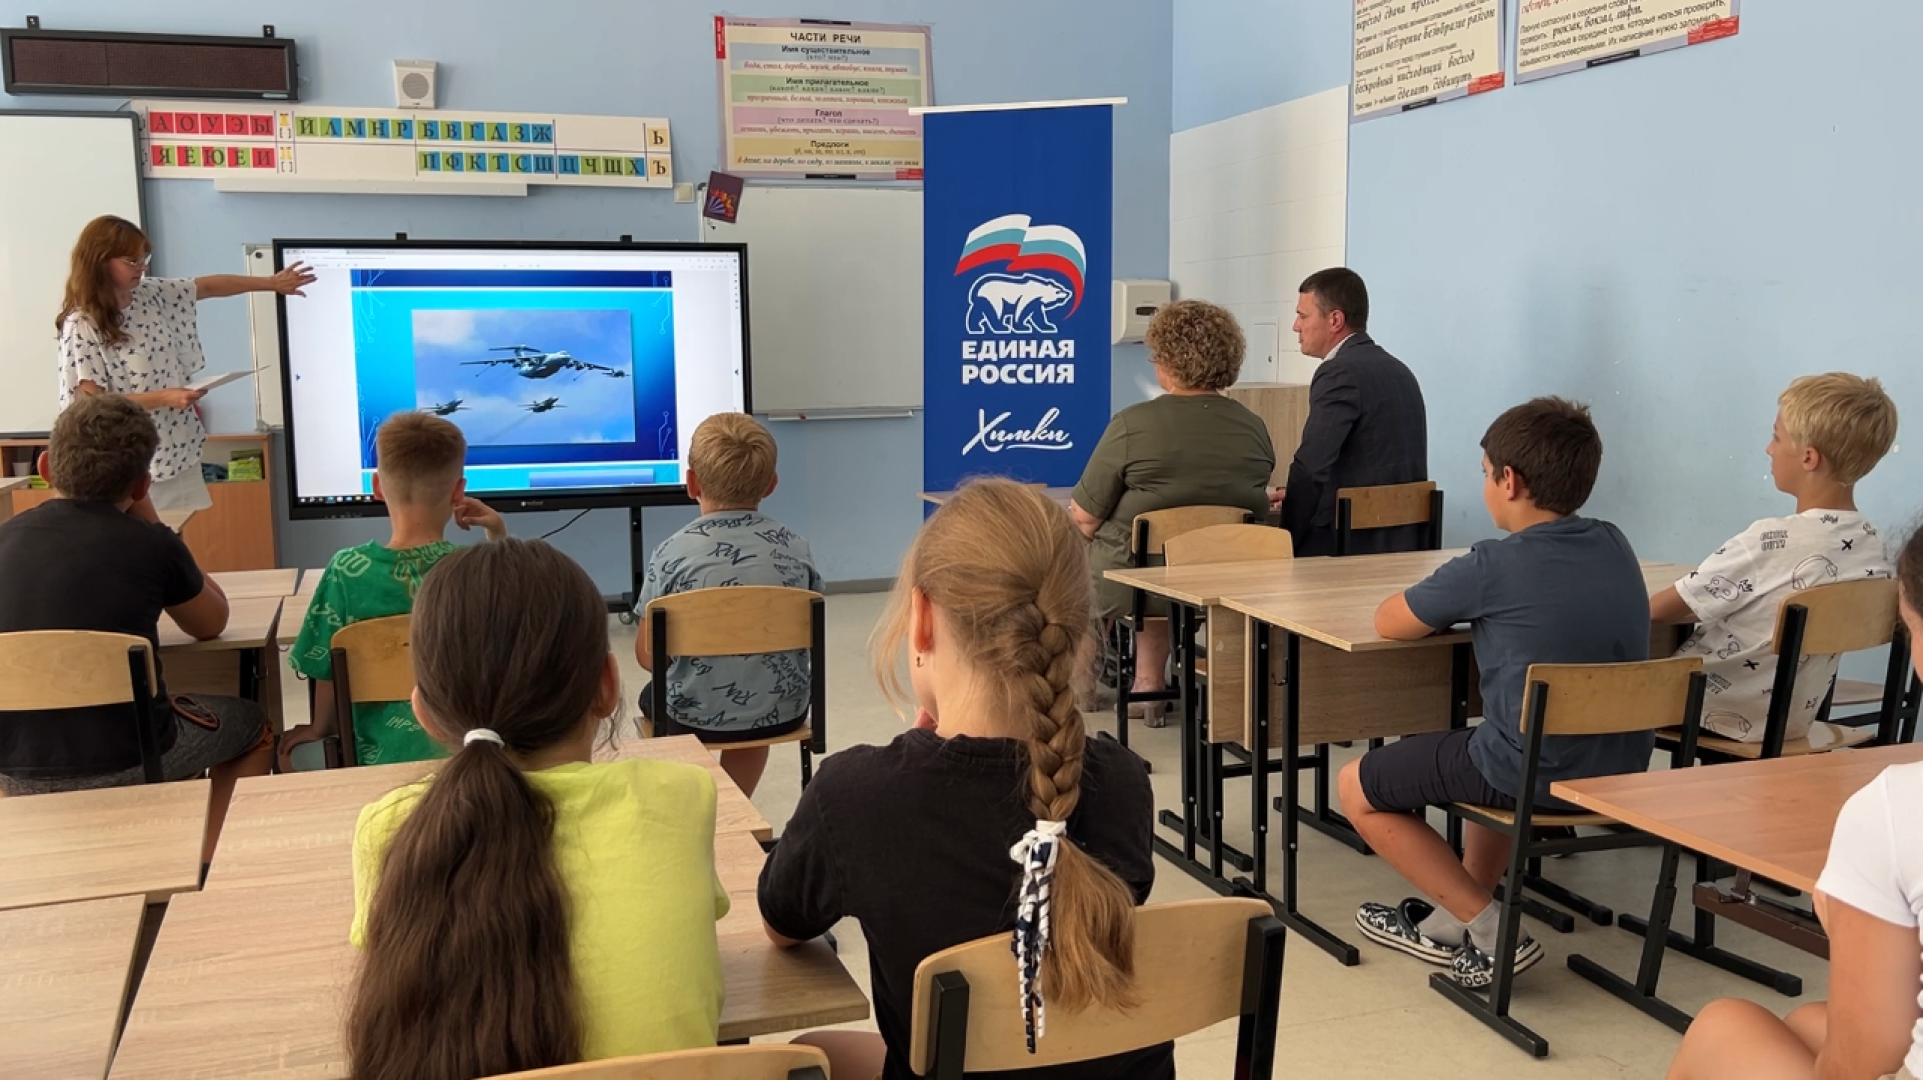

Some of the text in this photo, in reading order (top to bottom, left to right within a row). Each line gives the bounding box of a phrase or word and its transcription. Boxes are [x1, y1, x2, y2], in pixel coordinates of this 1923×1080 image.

[790, 31, 861, 43] ЧАСТИ РЕЧИ
[781, 45, 871, 56] Имя существительное
[786, 77, 869, 87] Имя прилагательное
[815, 108, 842, 118] Глагол
[810, 140, 849, 149] Предлоги
[962, 339, 1075, 361] ЕДИНАЯ
[962, 364, 1075, 385] РОССИЯ
[962, 407, 1071, 456] Химки
